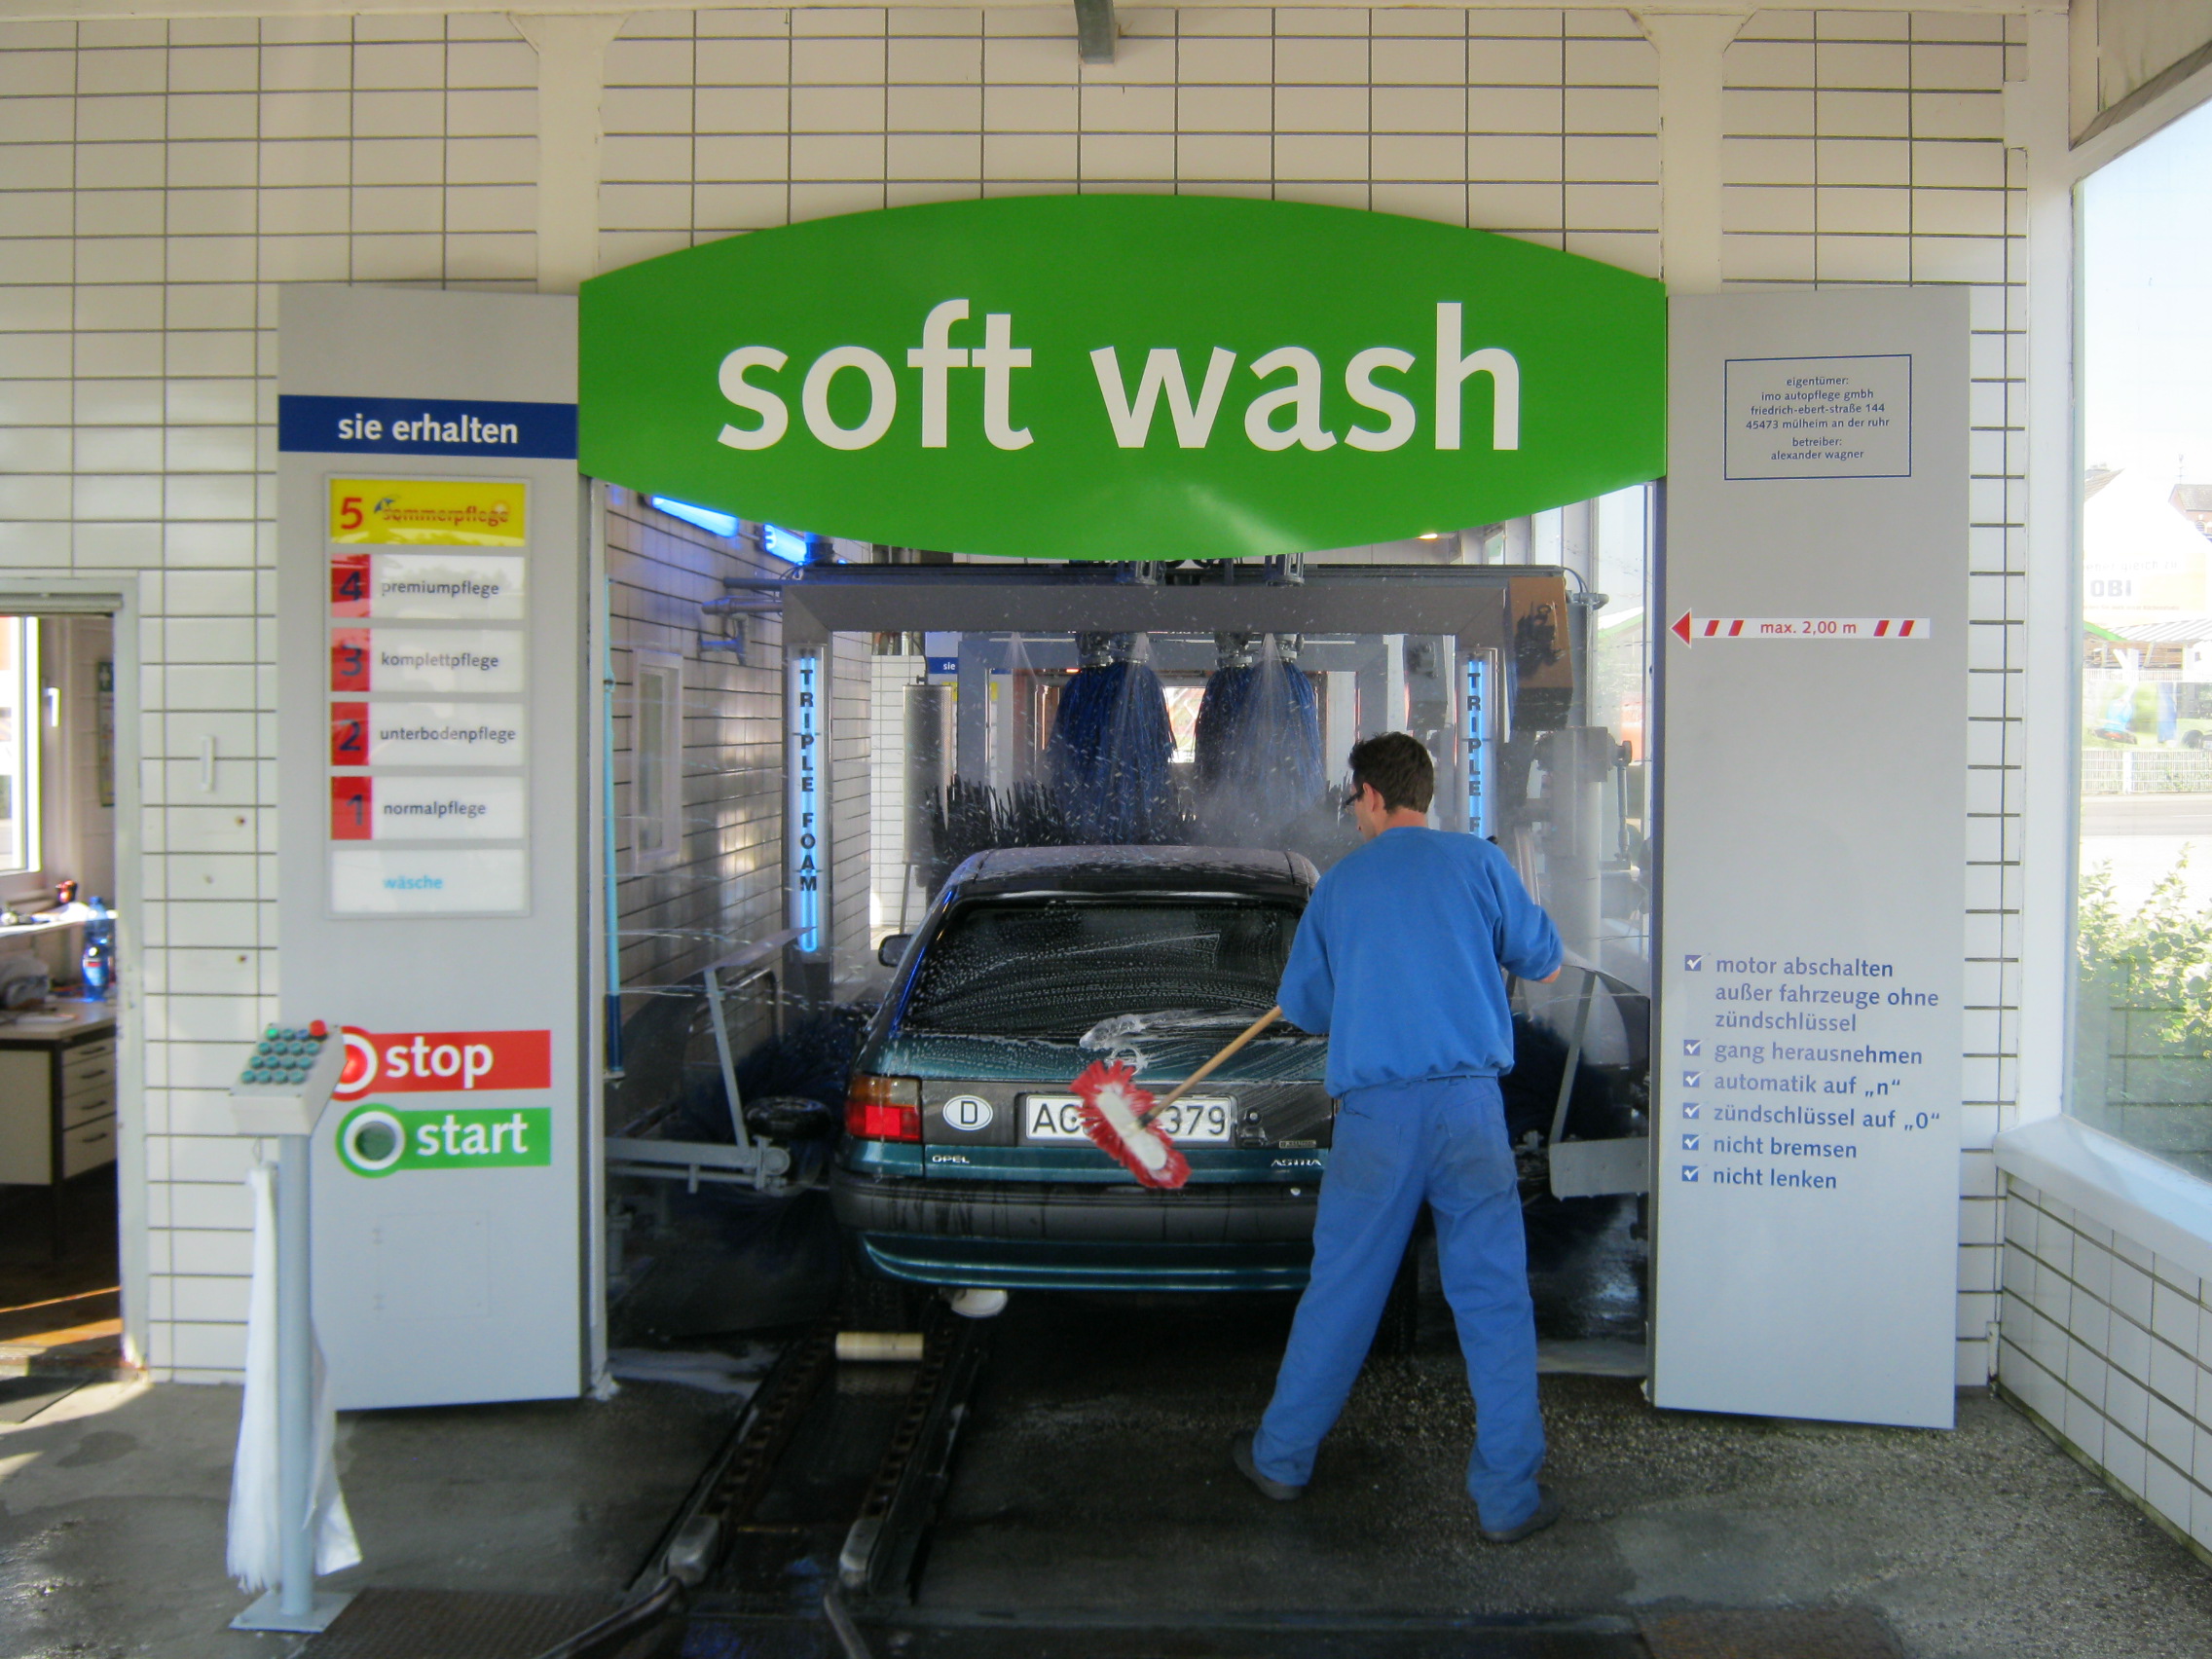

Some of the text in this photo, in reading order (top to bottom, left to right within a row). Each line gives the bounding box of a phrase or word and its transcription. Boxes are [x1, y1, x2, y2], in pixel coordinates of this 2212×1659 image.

[718, 299, 1521, 453] soft wash
[1787, 377, 1849, 387] eigentümer:
[1761, 389, 1873, 401] imo autopflege gmbh
[1751, 403, 1861, 415] friedrich-ebert-straße
[339, 414, 518, 444] sie erhalten
[1747, 420, 1778, 429] 45473
[1783, 418, 1827, 428] mülheim
[1848, 418, 1863, 427] der
[1868, 418, 1889, 426] ruhr
[1792, 437, 1842, 447] betreiber:
[1771, 450, 1863, 460] alexander wagner
[341, 498, 509, 529] 5 sommerpflege
[339, 571, 498, 601] 4 premiumpflege
[2090, 579, 2132, 597] OBI
[1760, 621, 1857, 635] max. 2,00 m
[341, 645, 498, 676] 3 komplettpflege
[339, 720, 515, 751] 2 unterbodenpflege
[1467, 672, 1481, 796] TRIPLE
[800, 669, 817, 892] TRIPLE FOAM
[347, 795, 486, 826] 1 normalpflege
[383, 875, 443, 890] wäsche
[1716, 958, 1893, 977] motor abschalten
[1715, 983, 1938, 1009] außer fahrzeuge ohne
[1715, 1012, 1856, 1031] zündschlüssel
[386, 1036, 493, 1088] stop
[1714, 1043, 1922, 1063] gang herausnehmen
[1714, 1073, 1816, 1092] automatik
[1825, 1077, 1857, 1094] auf
[961, 1100, 977, 1124] D
[1714, 1105, 1855, 1125] zündschlüssel
[1862, 1110, 1895, 1127] auf
[417, 1114, 528, 1157] start
[1714, 1136, 1857, 1158] nicht bremsen
[932, 1154, 971, 1163] OPEL
[1271, 1158, 1322, 1167] ASTRA
[1714, 1167, 1836, 1189] nicht lenken
